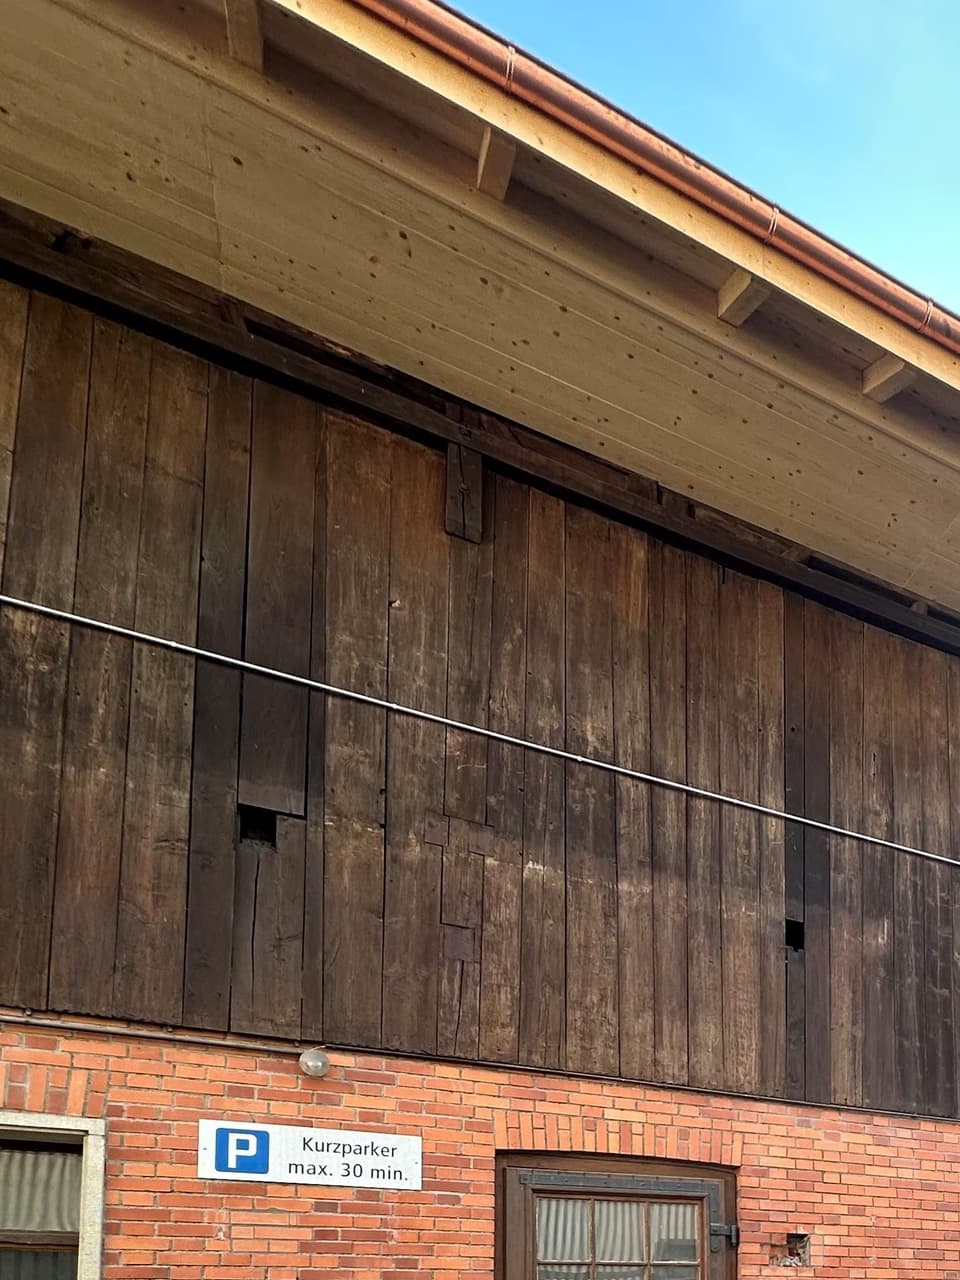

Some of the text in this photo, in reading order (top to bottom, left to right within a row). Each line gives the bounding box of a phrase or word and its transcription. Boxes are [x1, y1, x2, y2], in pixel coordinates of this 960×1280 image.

[227, 1132, 257, 1168] P
[302, 1137, 398, 1158] Kurzparker
[288, 1162, 408, 1181] max. 30 min.
